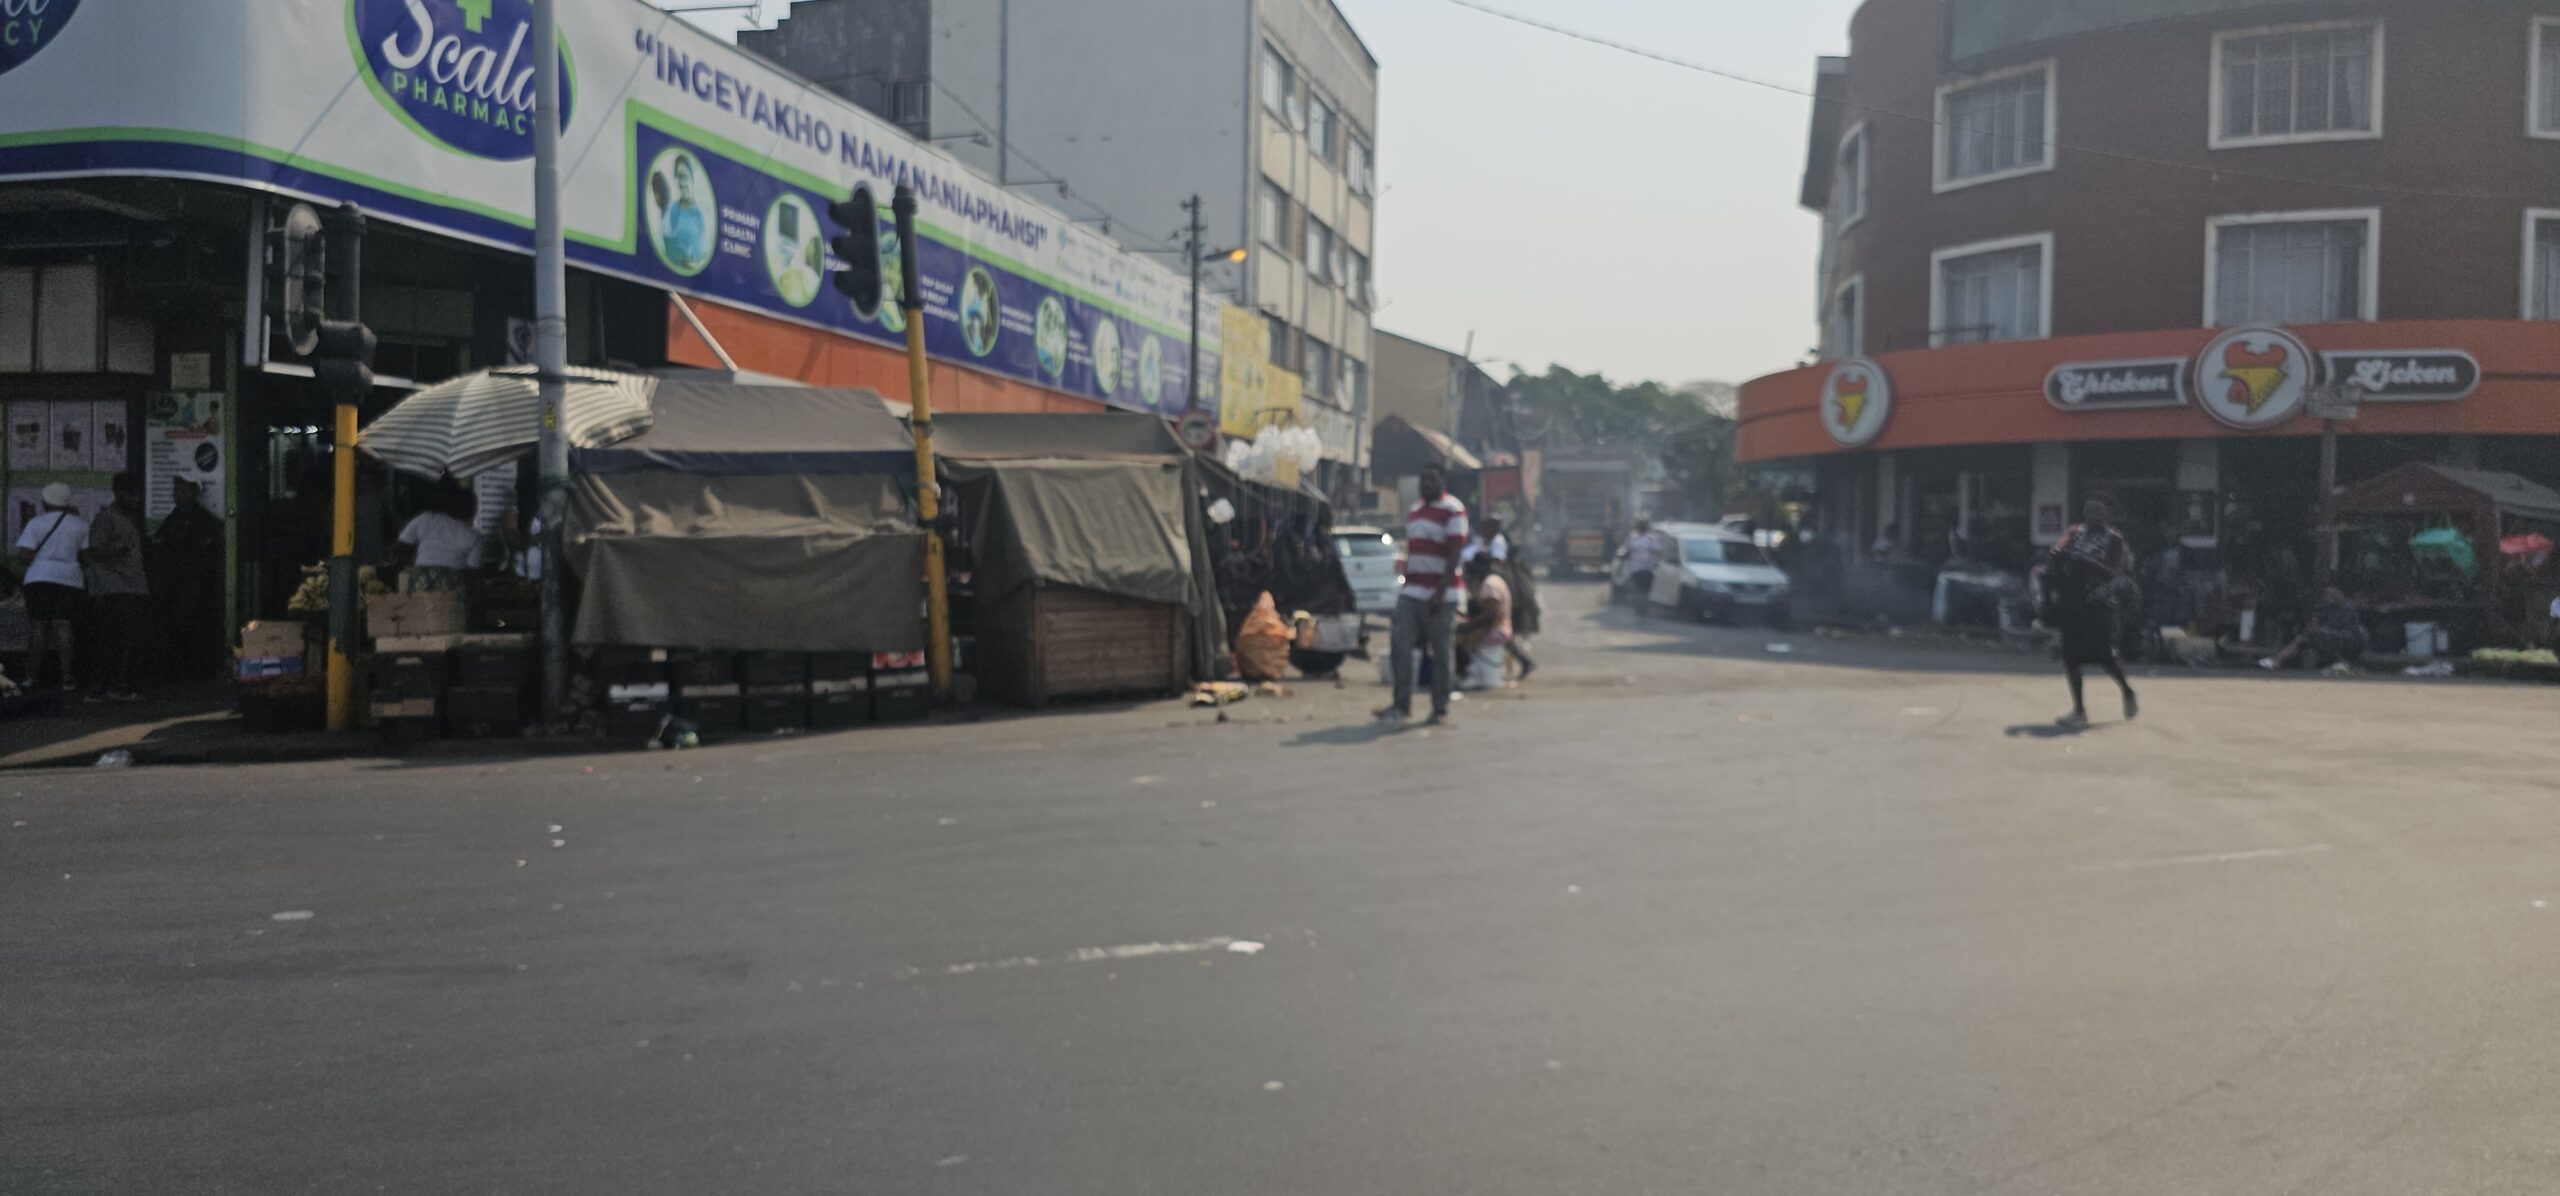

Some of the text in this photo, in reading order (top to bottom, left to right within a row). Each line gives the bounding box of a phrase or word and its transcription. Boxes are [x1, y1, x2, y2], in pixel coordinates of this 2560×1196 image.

[392, 70, 536, 136] PHARMAC
[2057, 359, 2457, 404] Chicken Licken
